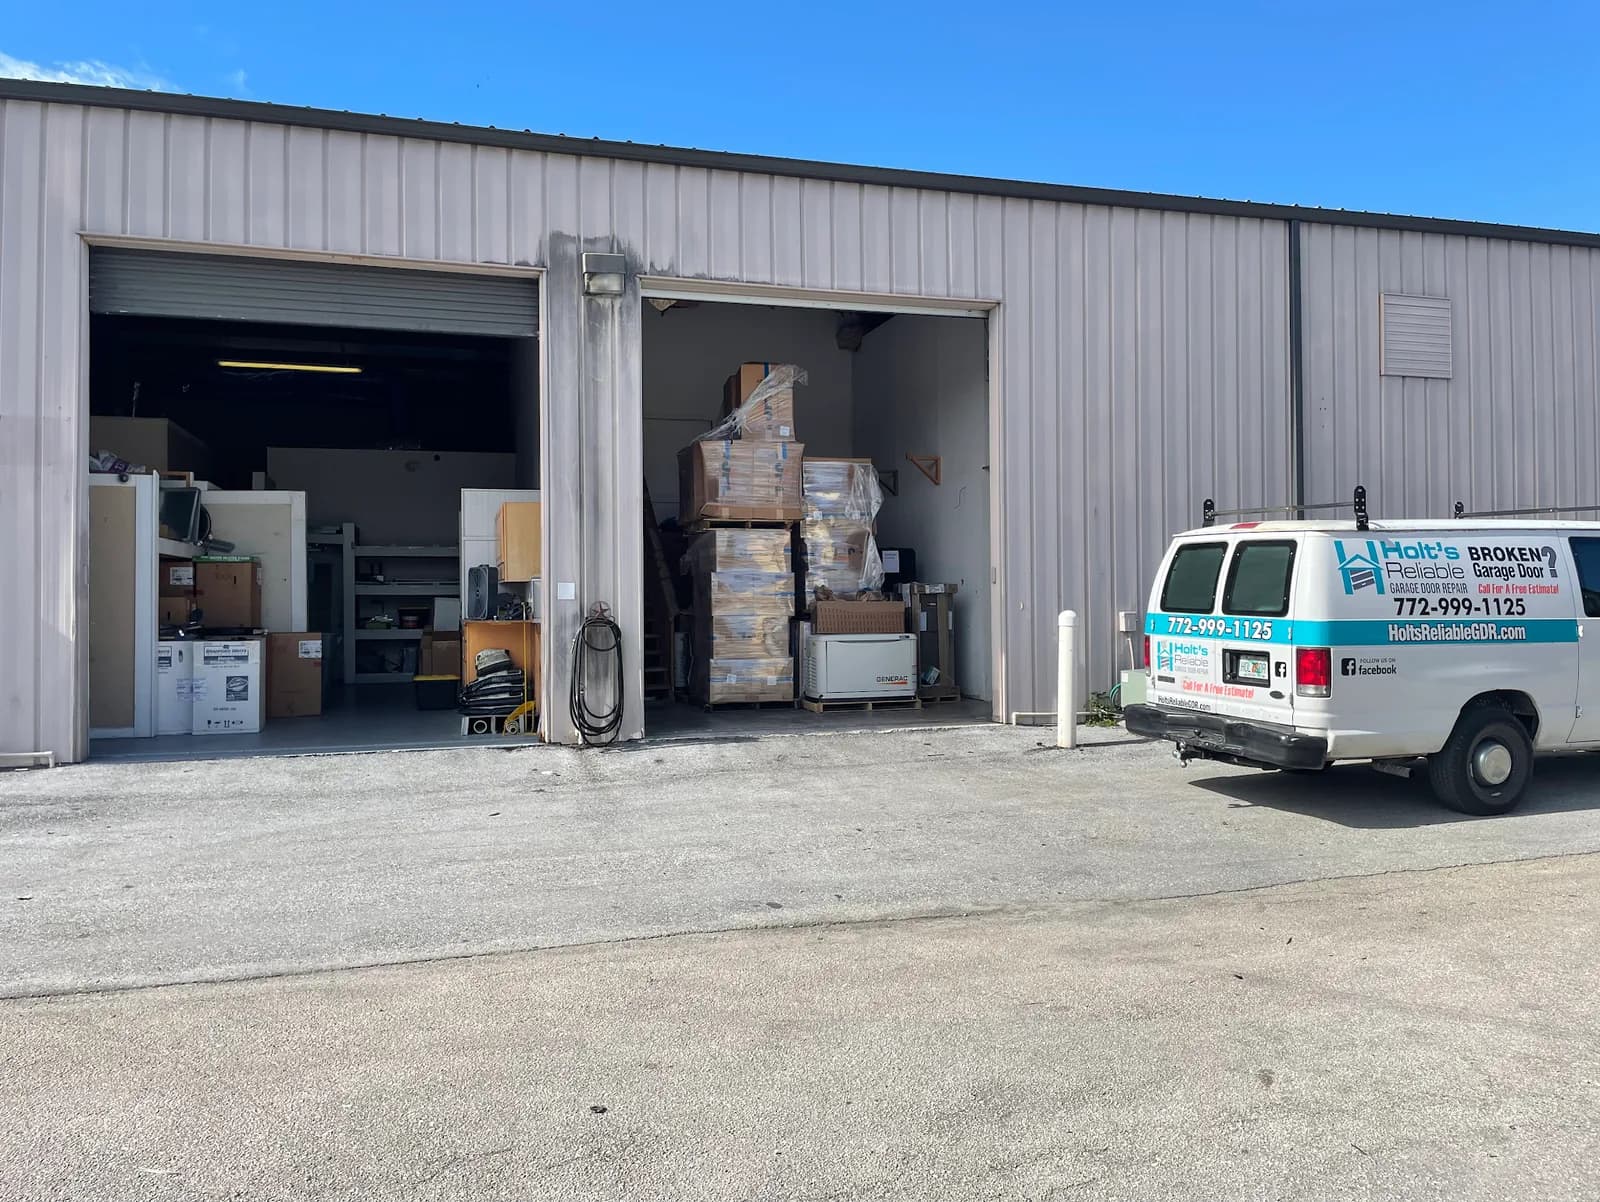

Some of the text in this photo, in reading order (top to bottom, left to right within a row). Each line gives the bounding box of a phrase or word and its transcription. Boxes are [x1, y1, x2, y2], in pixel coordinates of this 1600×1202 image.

[1380, 541, 1460, 560] Holt's
[1468, 546, 1542, 562] BROKEN
[1386, 562, 1465, 579] Reliable
[1472, 563, 1544, 581] Garage Door
[1390, 583, 1468, 594] GARAGE DOOR REPAIR
[1478, 583, 1559, 595] Call For A Free Estimate!
[1393, 597, 1526, 616] 772-999-1125
[1167, 616, 1273, 641] 772-999-1125
[1387, 623, 1526, 642] HoltsReliableGDR.com
[1174, 643, 1209, 656] Holt's
[1359, 664, 1397, 675] facebook
